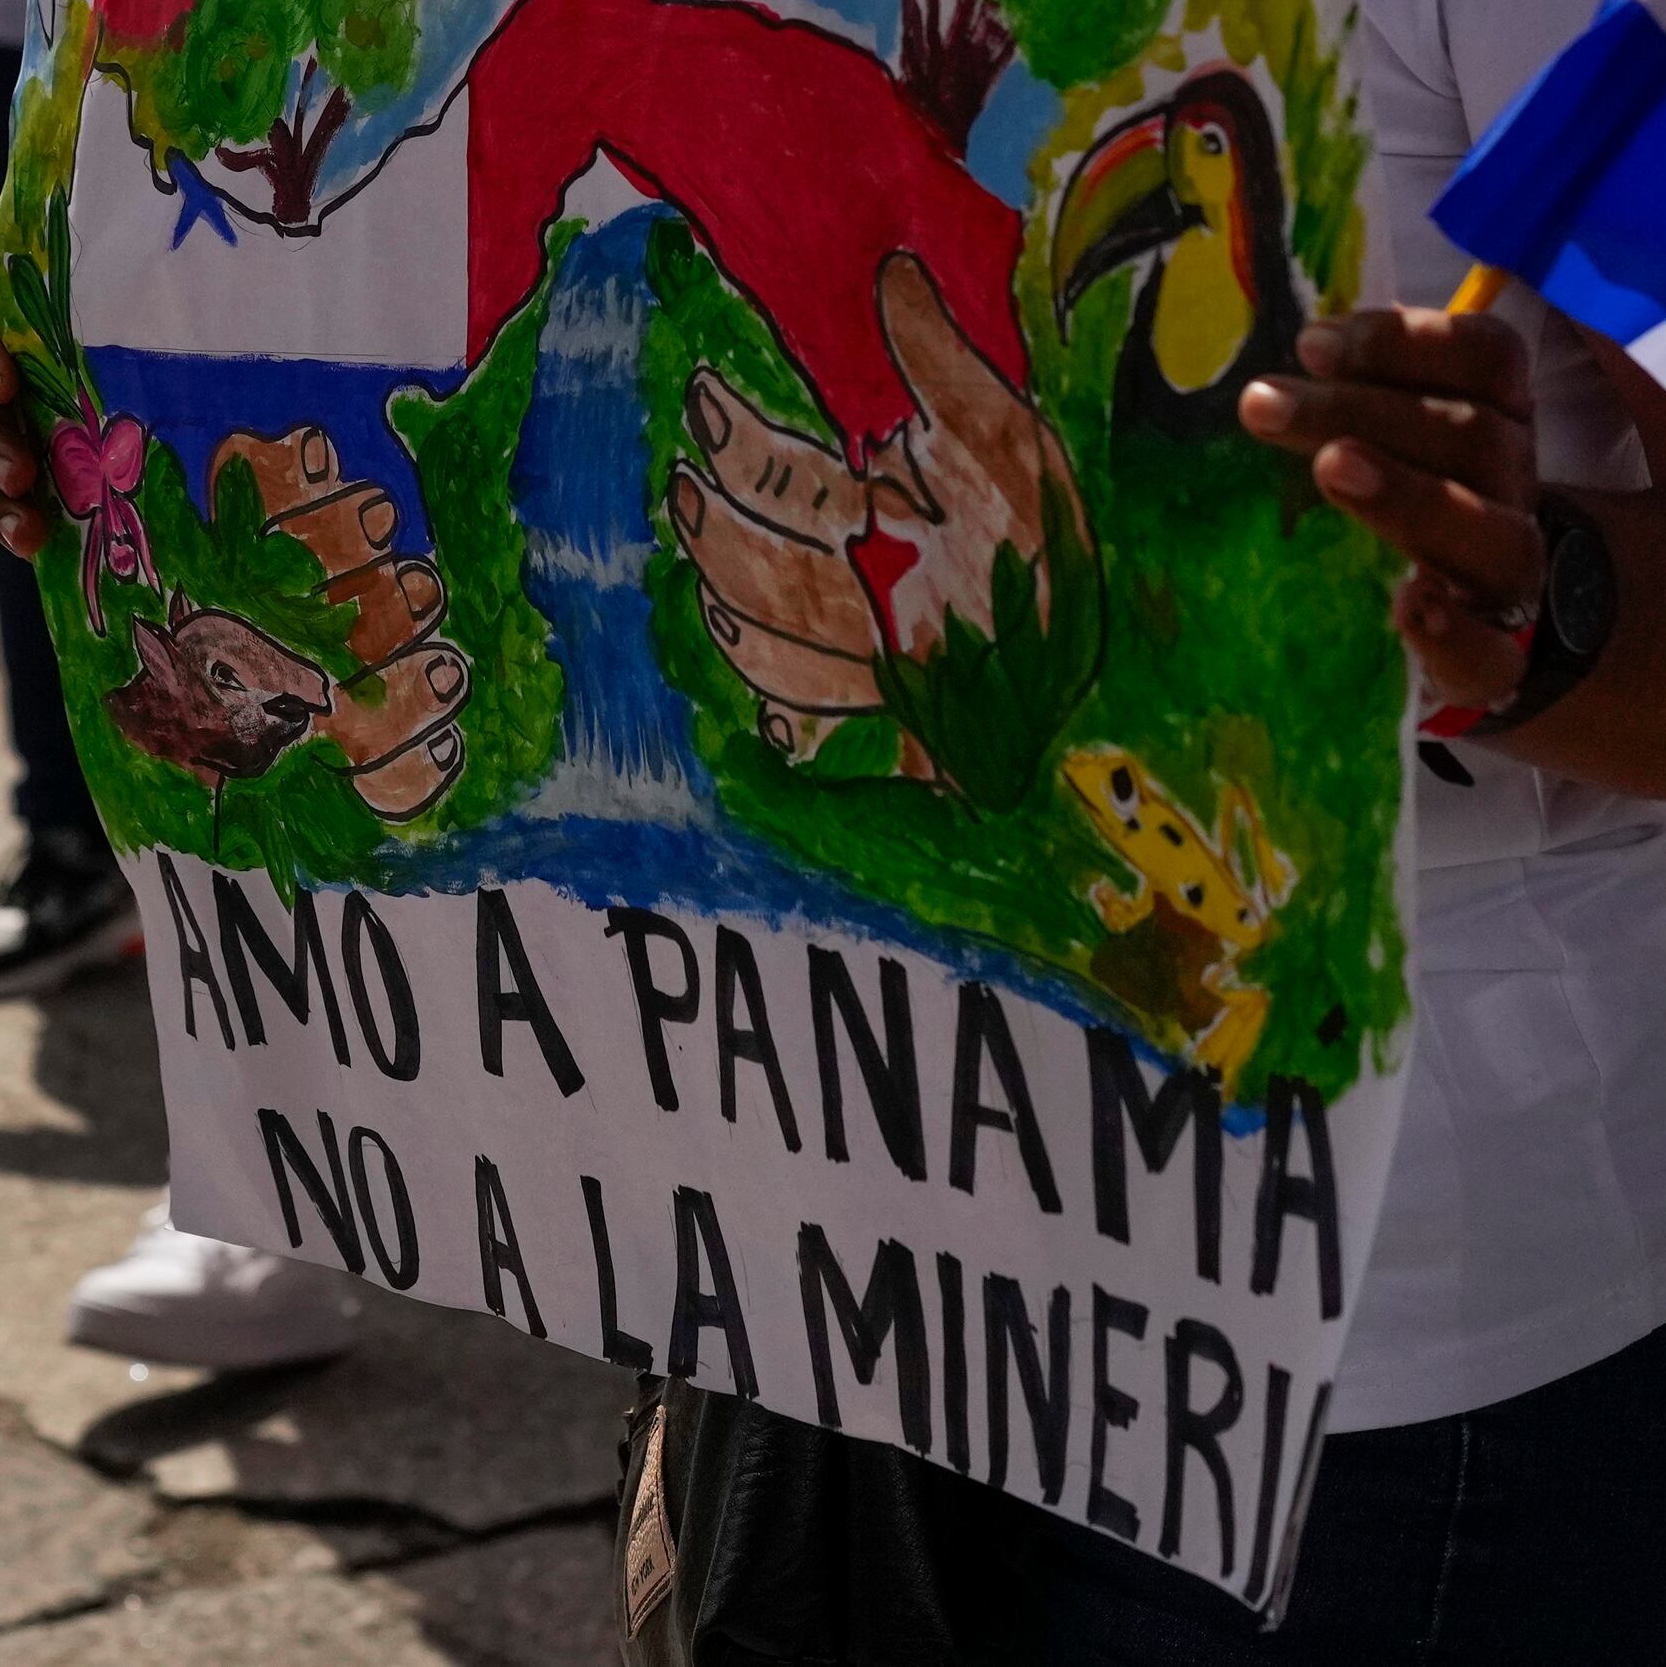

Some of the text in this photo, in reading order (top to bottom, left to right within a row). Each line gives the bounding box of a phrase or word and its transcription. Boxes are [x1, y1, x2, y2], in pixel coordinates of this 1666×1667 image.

[157, 850, 1342, 1321] AMO A PANAMA
[256, 1108, 420, 1291] NO
[473, 1154, 547, 1339] A
[581, 1175, 760, 1400] LA
